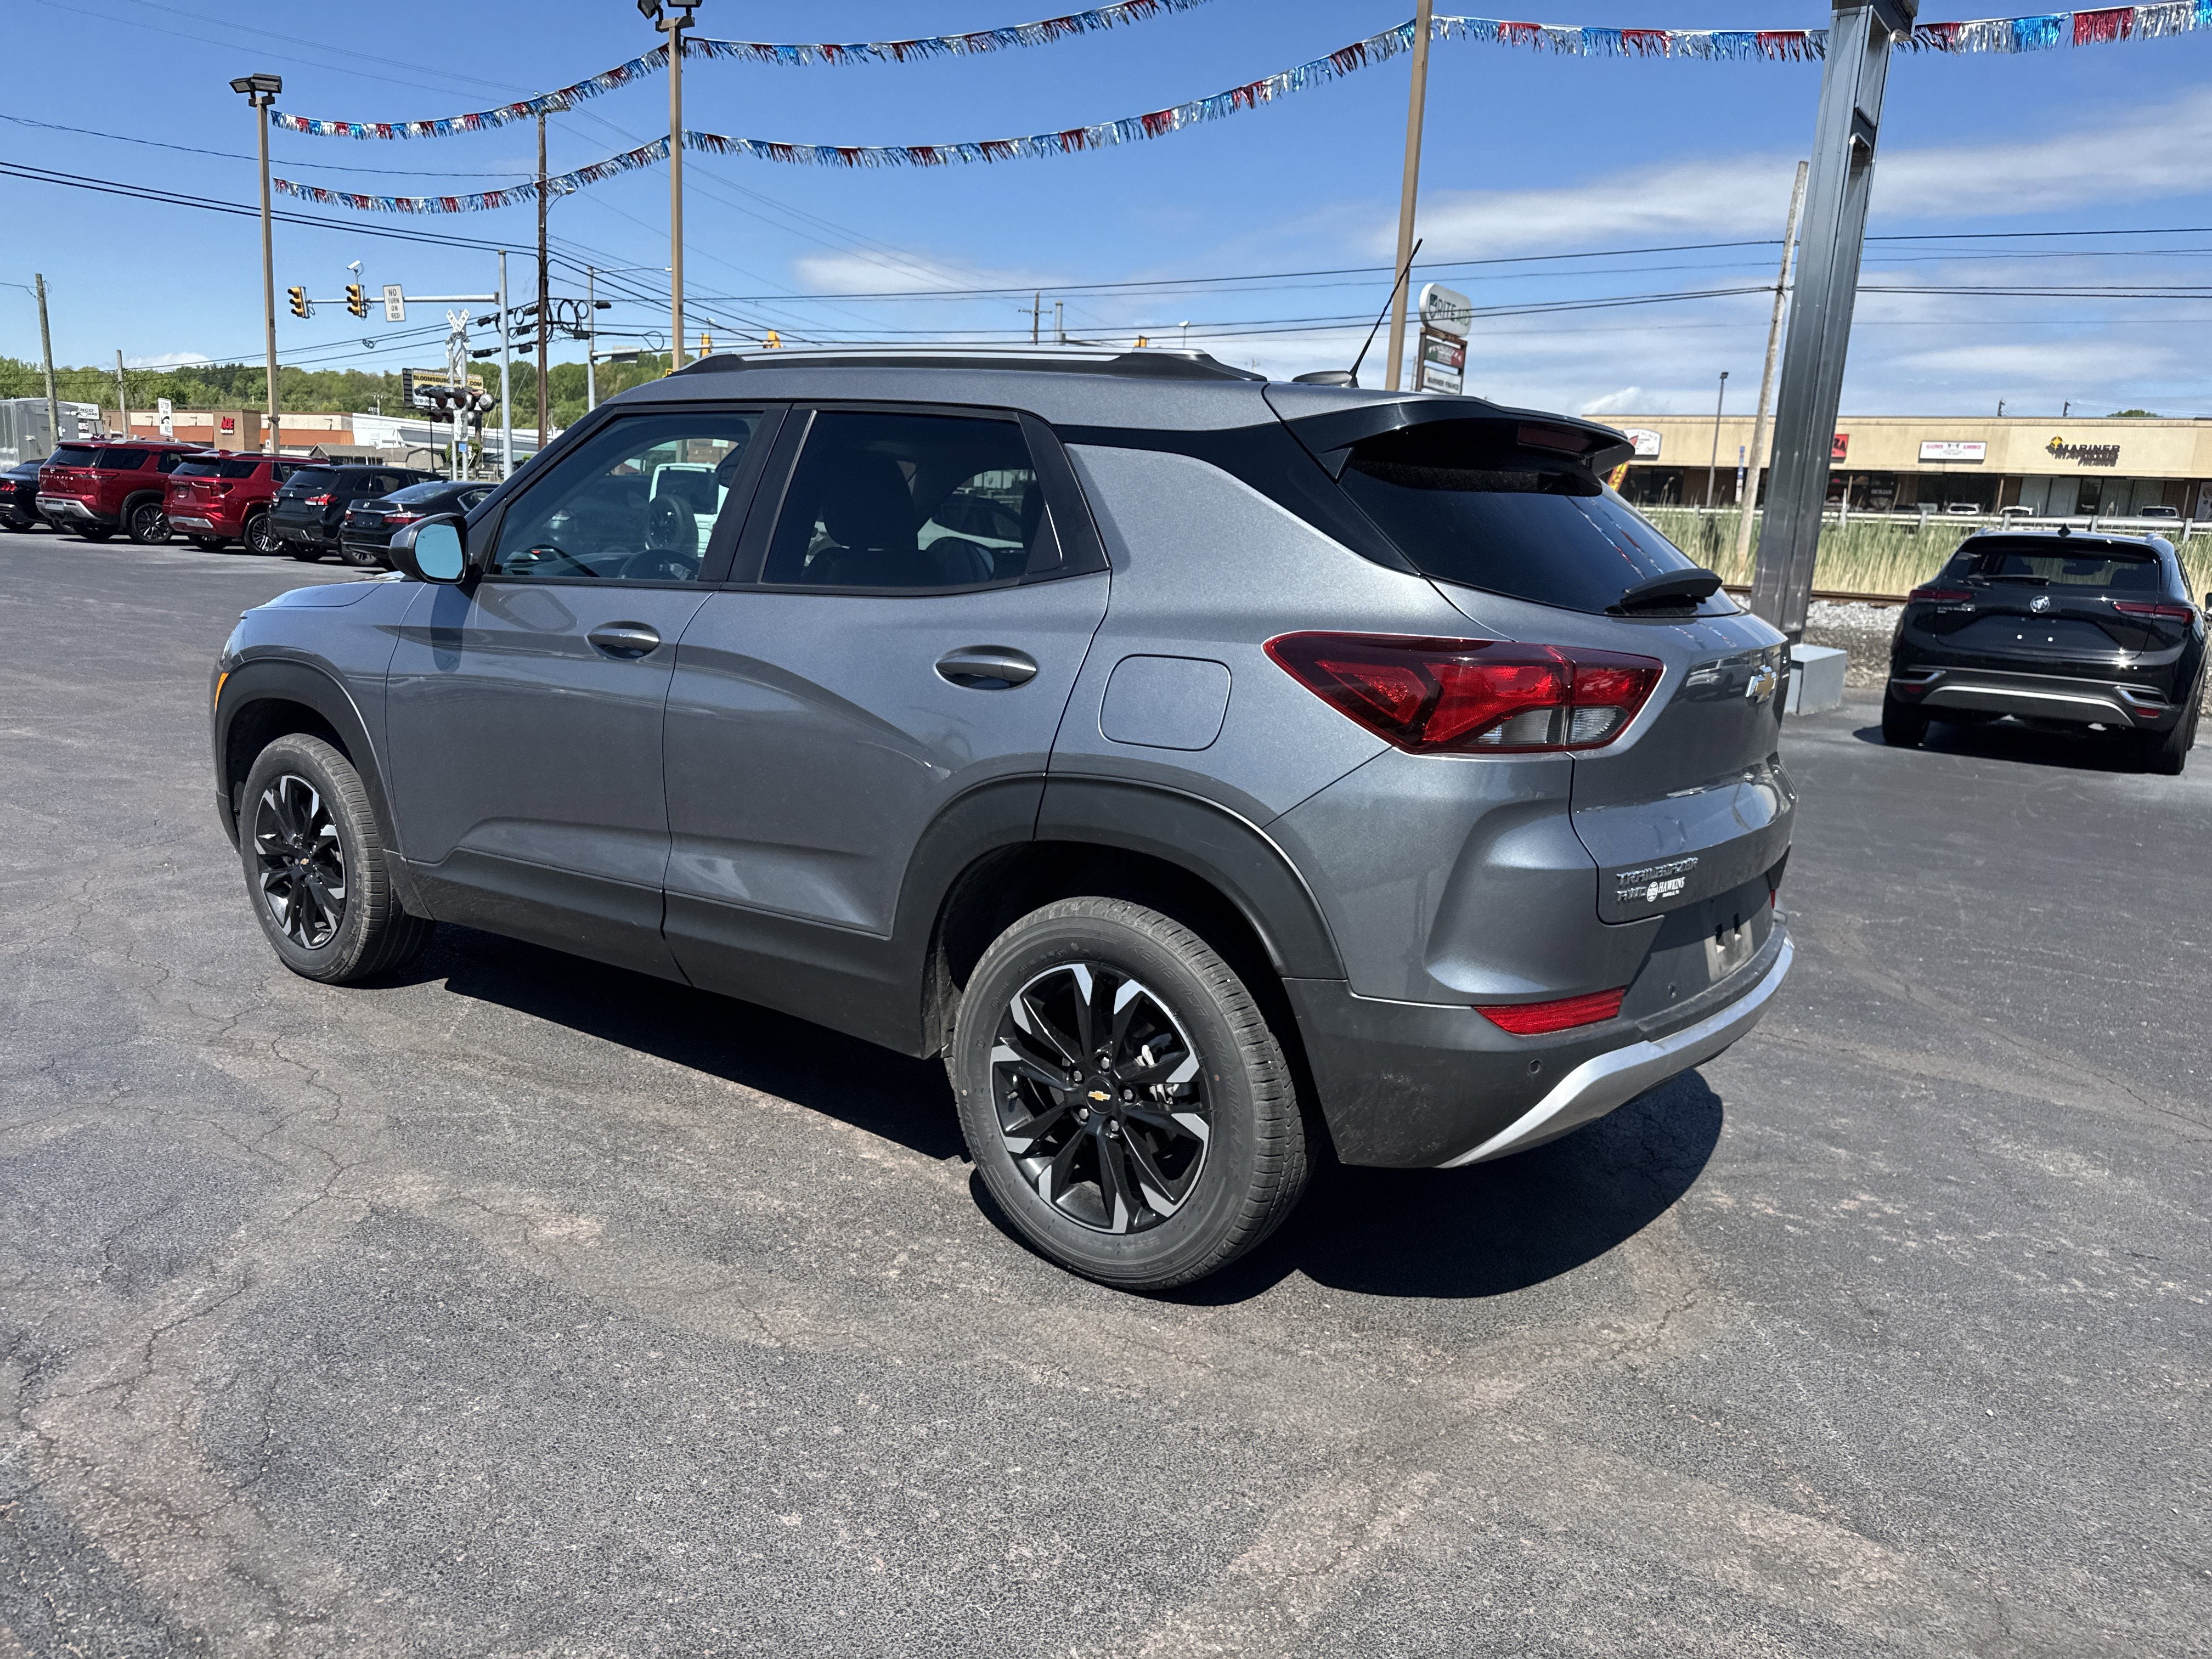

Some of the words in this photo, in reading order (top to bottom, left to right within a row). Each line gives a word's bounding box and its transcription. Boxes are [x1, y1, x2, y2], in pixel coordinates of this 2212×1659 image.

[388, 288, 397, 297] NO
[1438, 298, 1457, 323] RITE
[160, 401, 170, 409] STOP
[220, 416, 235, 430] ACE
[1658, 876, 1685, 894] HAWKINS
